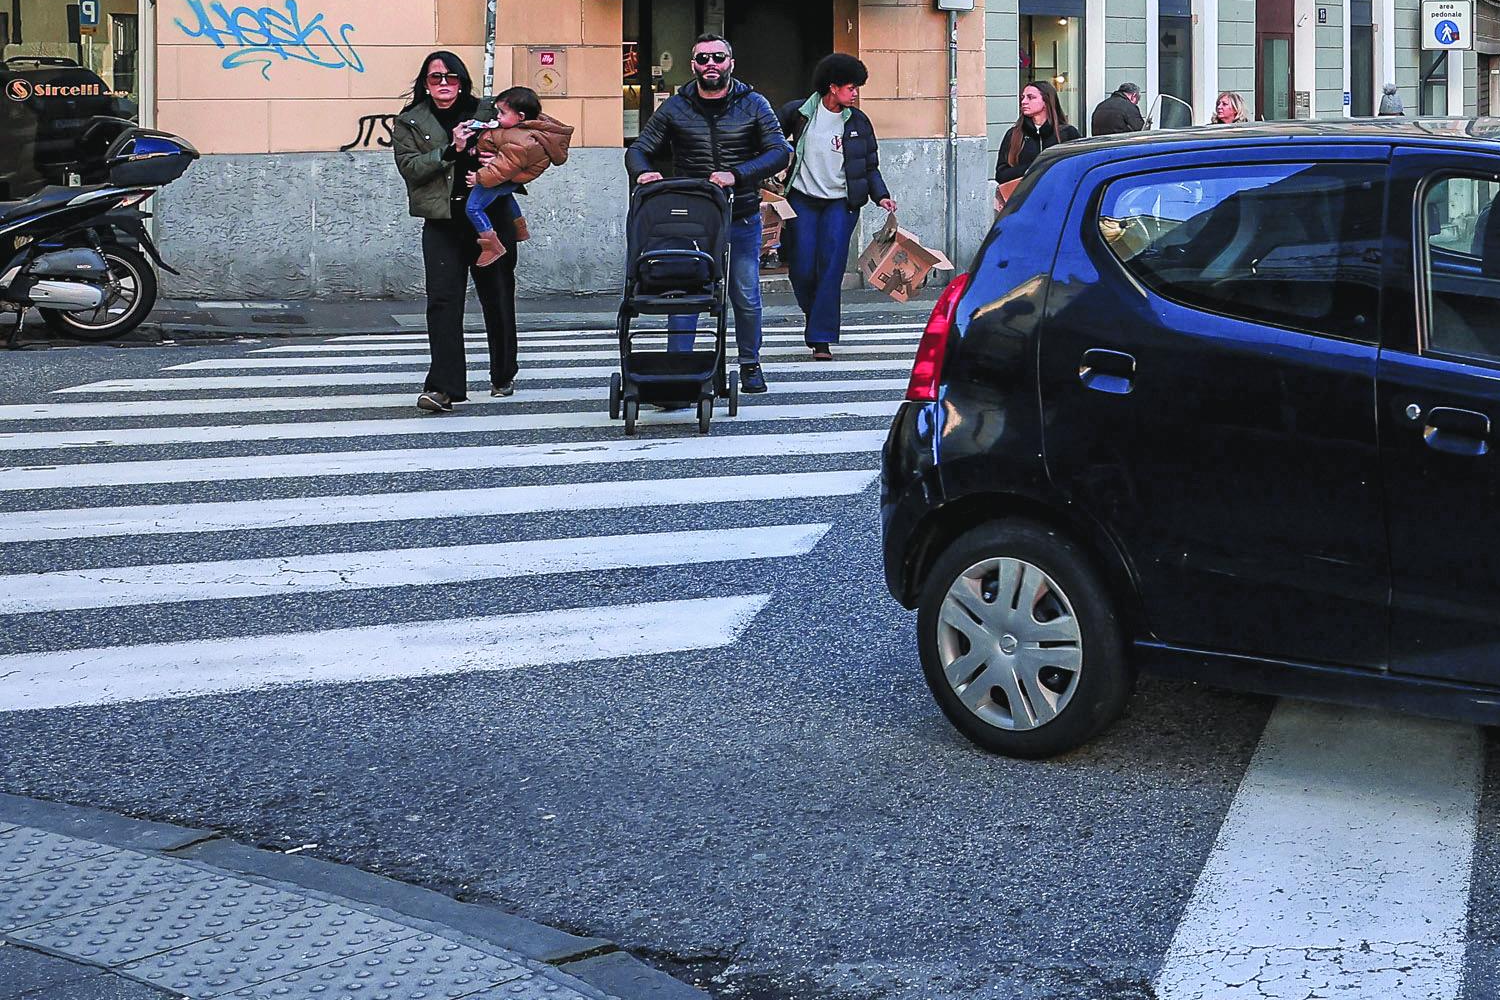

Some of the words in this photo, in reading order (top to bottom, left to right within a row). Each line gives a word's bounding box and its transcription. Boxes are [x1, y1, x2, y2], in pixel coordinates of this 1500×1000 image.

[1431, 11, 1462, 19] pedonale
[541, 54, 554, 65] illy
[34, 83, 100, 96] Sircelli
